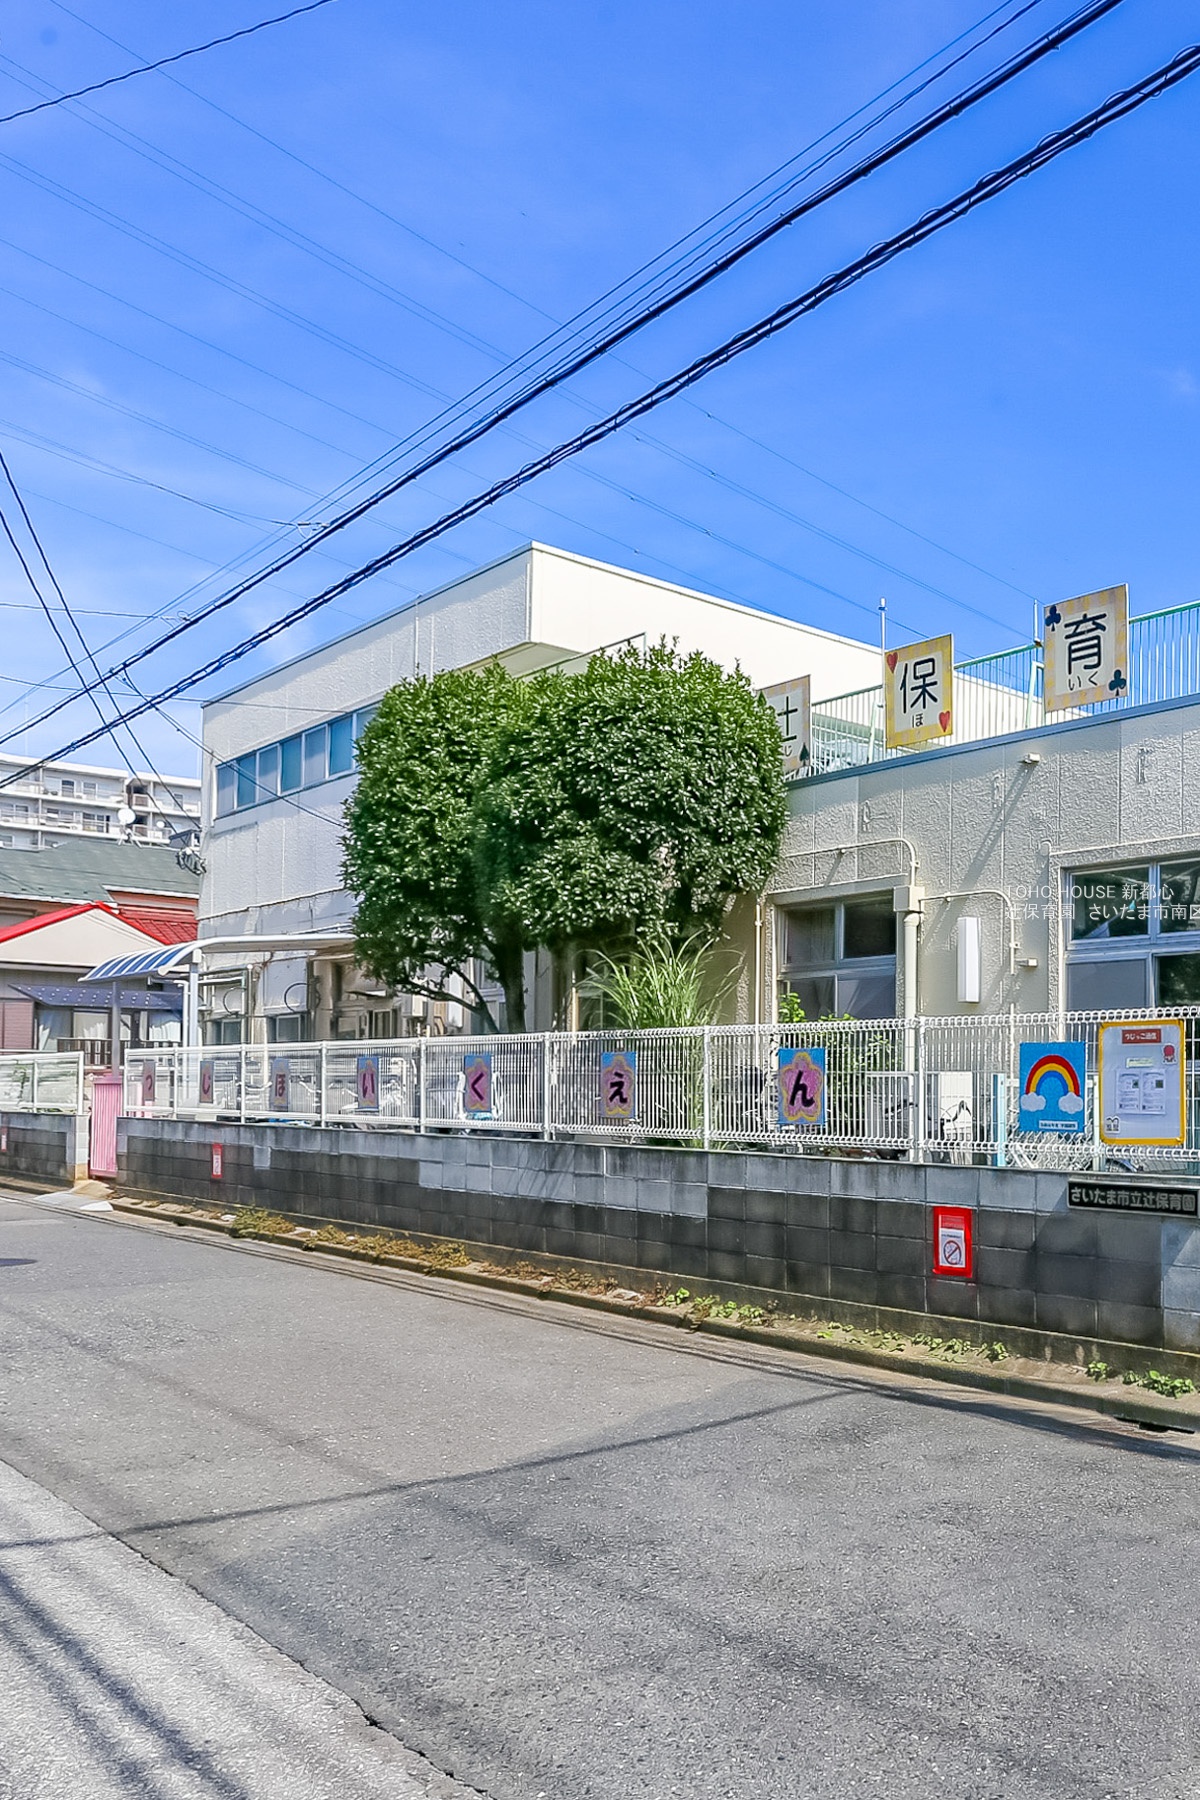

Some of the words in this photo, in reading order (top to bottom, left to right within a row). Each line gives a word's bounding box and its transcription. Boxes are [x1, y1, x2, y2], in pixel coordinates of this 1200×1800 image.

[899, 658, 938, 715] 保
[1063, 612, 1108, 676] 育
[911, 712, 924, 728] ほ
[1067, 670, 1099, 692] いく
[360, 1068, 376, 1098] い
[470, 1074, 486, 1101] く
[608, 1070, 628, 1104] え
[789, 1069, 814, 1107] ん
[1071, 1186, 1196, 1212] さいたま市立辻保育園
